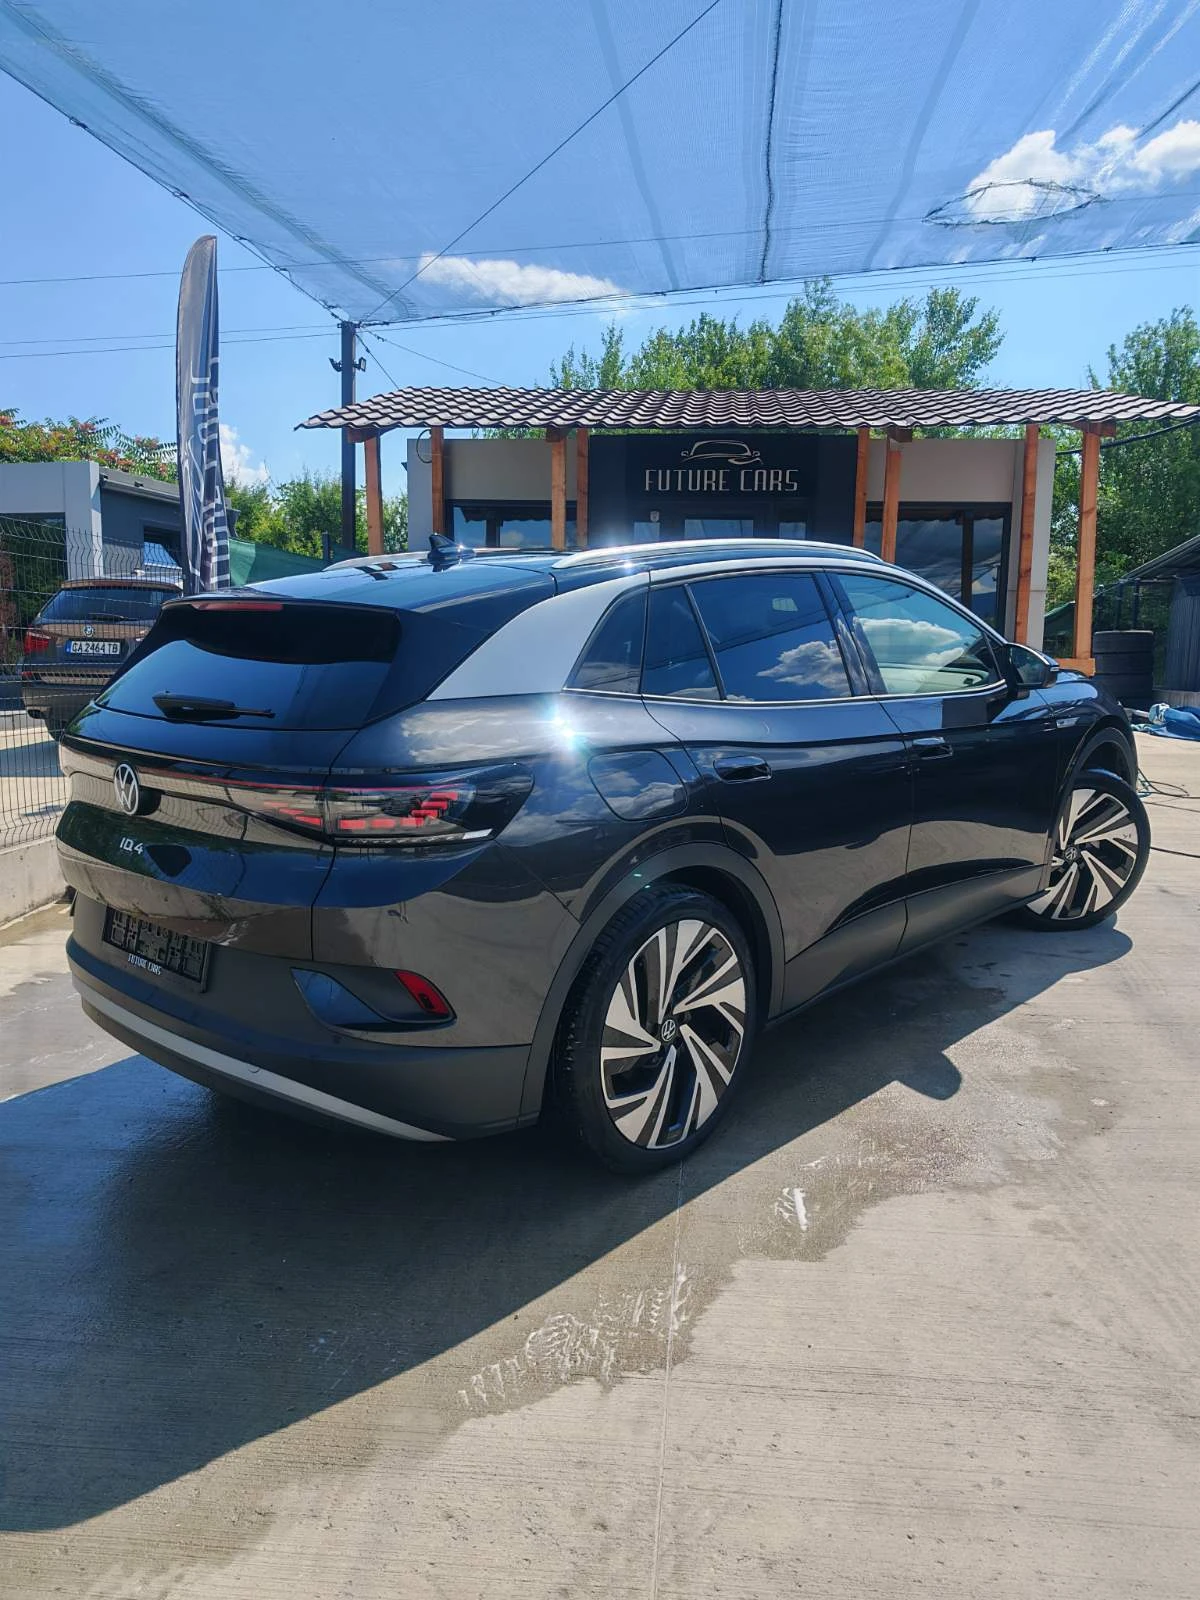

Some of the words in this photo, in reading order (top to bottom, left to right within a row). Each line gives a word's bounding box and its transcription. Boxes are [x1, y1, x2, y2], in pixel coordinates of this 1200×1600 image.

[645, 469, 730, 491] FUTURE
[740, 469, 799, 491] CARS
[84, 642, 106, 654] 2464
[108, 643, 119, 654] TB
[127, 952, 147, 969] FUTURE
[147, 960, 162, 976] CARS
